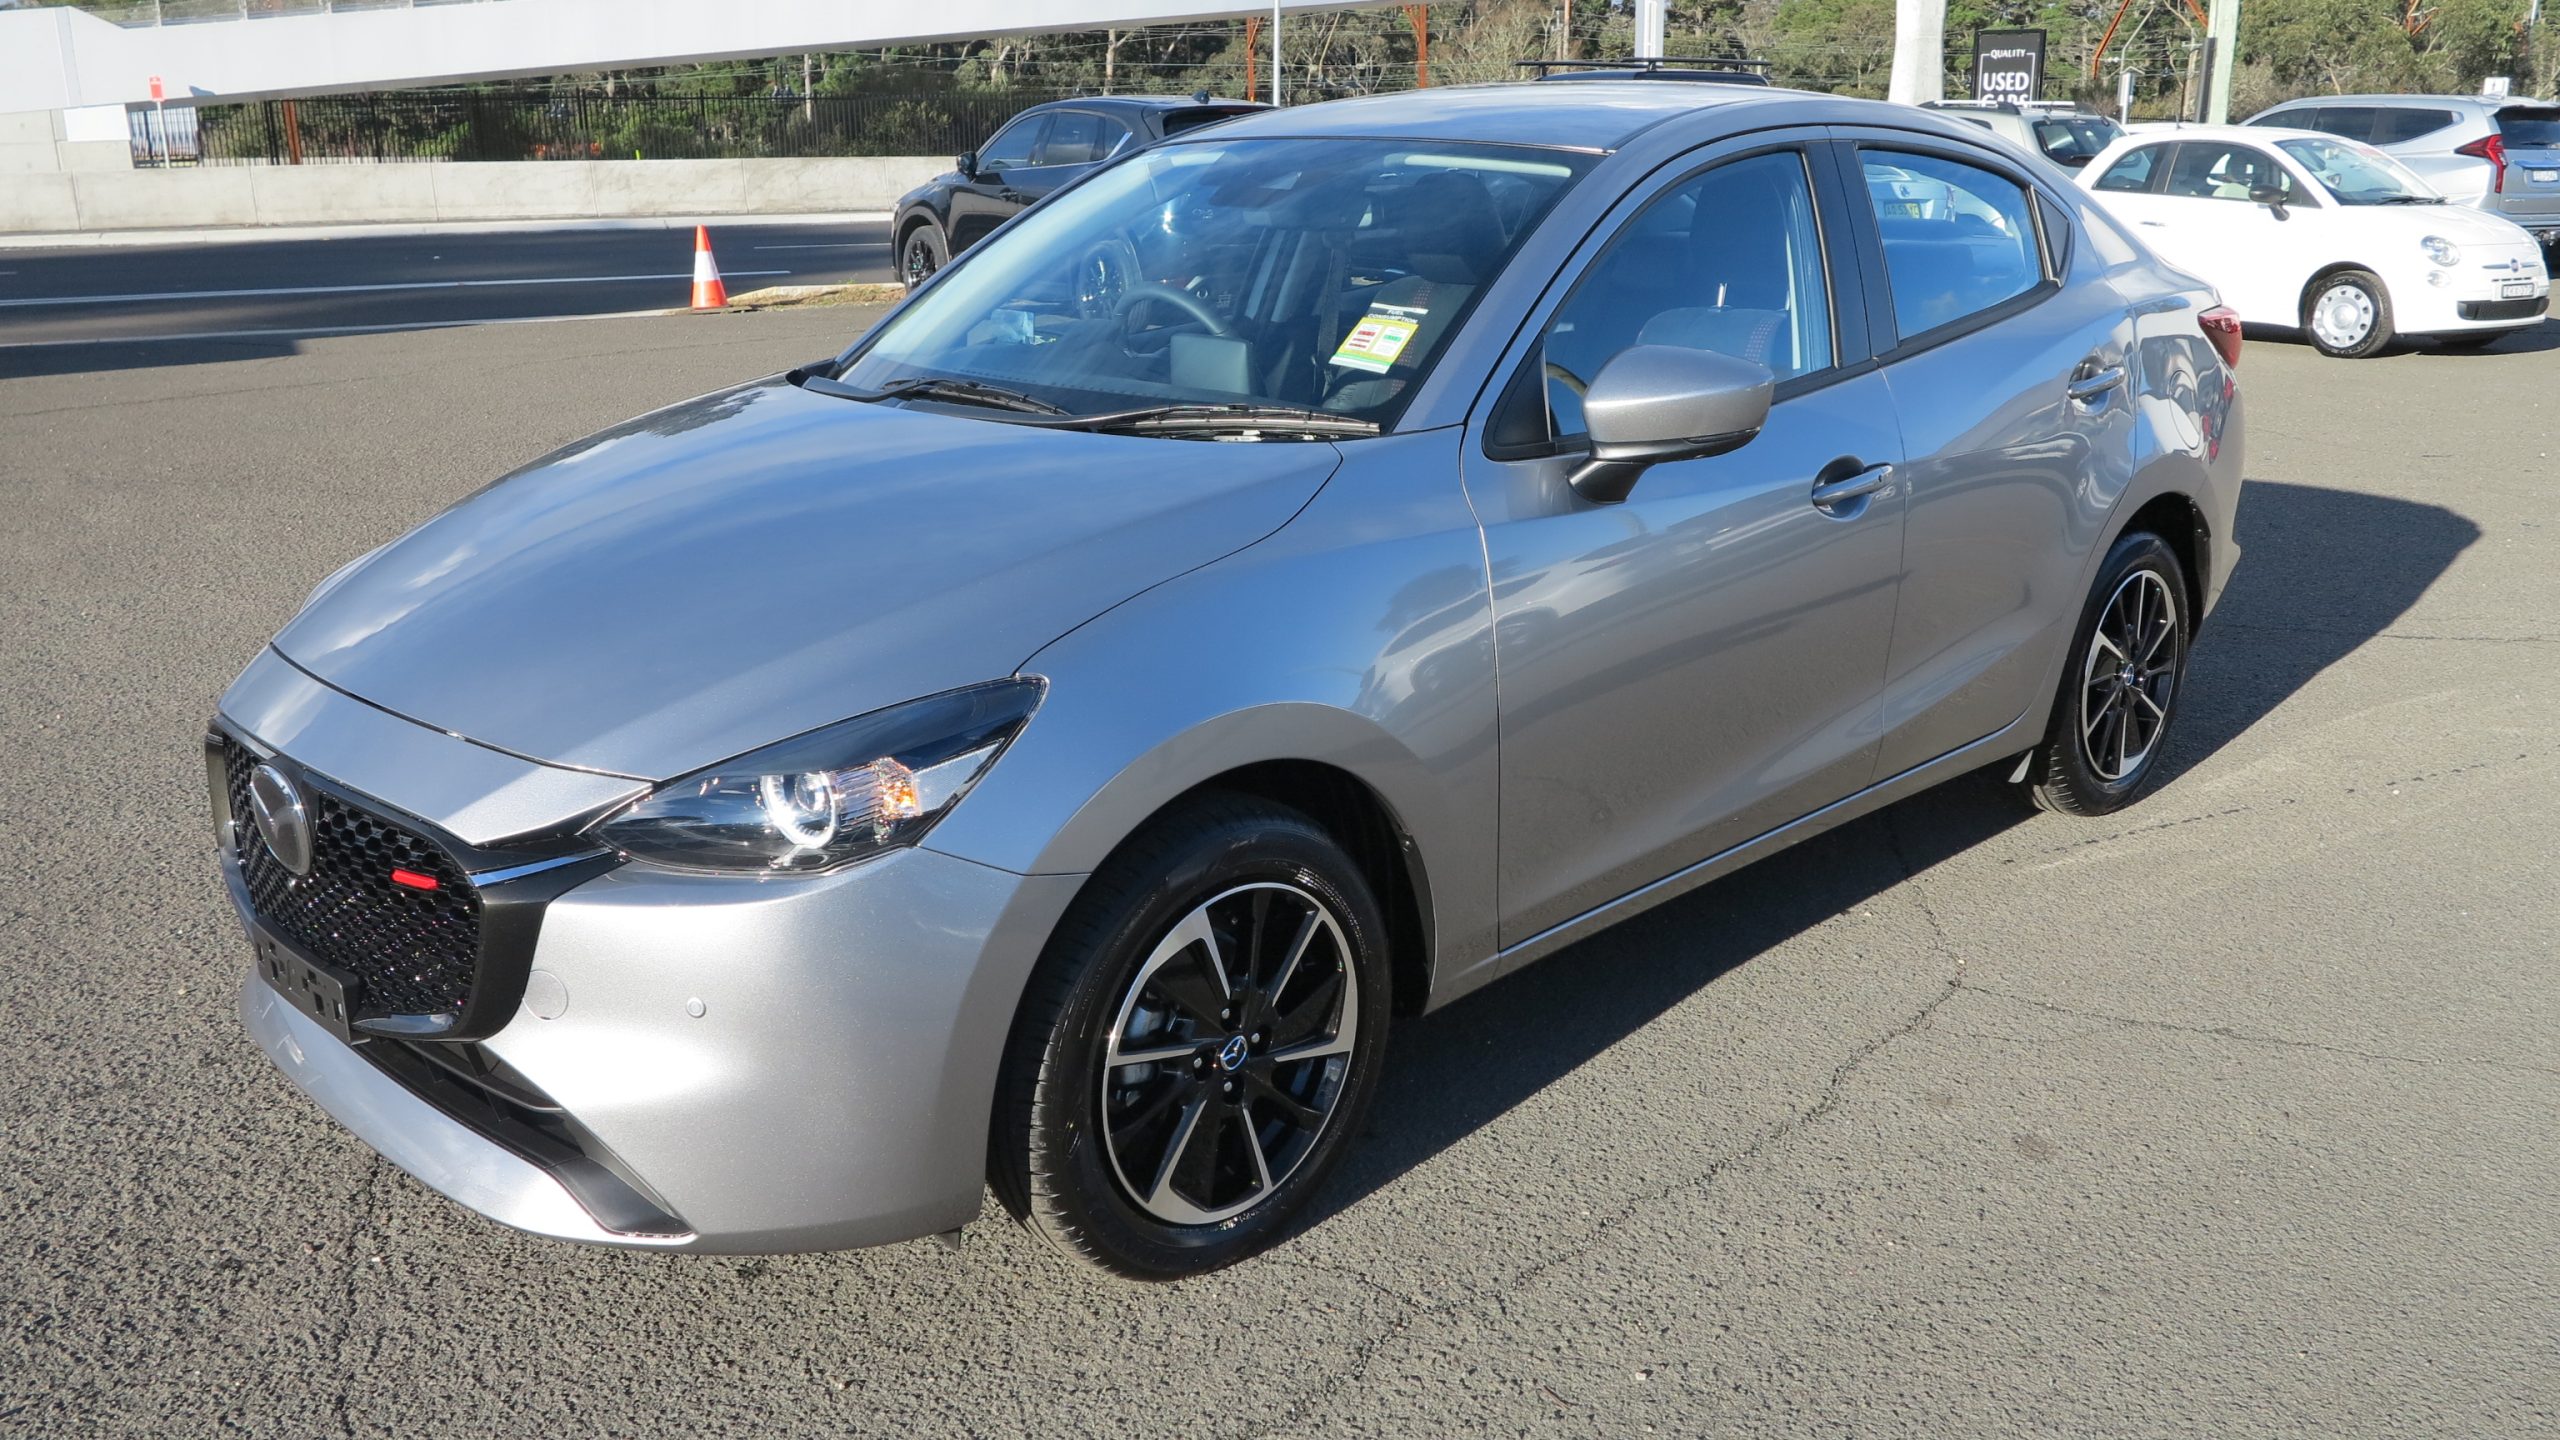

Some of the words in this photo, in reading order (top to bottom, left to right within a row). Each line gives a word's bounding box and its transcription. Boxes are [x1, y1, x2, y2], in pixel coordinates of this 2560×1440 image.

[1990, 49, 2026, 59] QUALITY
[1983, 72, 2030, 91] USED
[1367, 313, 1419, 324] CONSUMPTION
